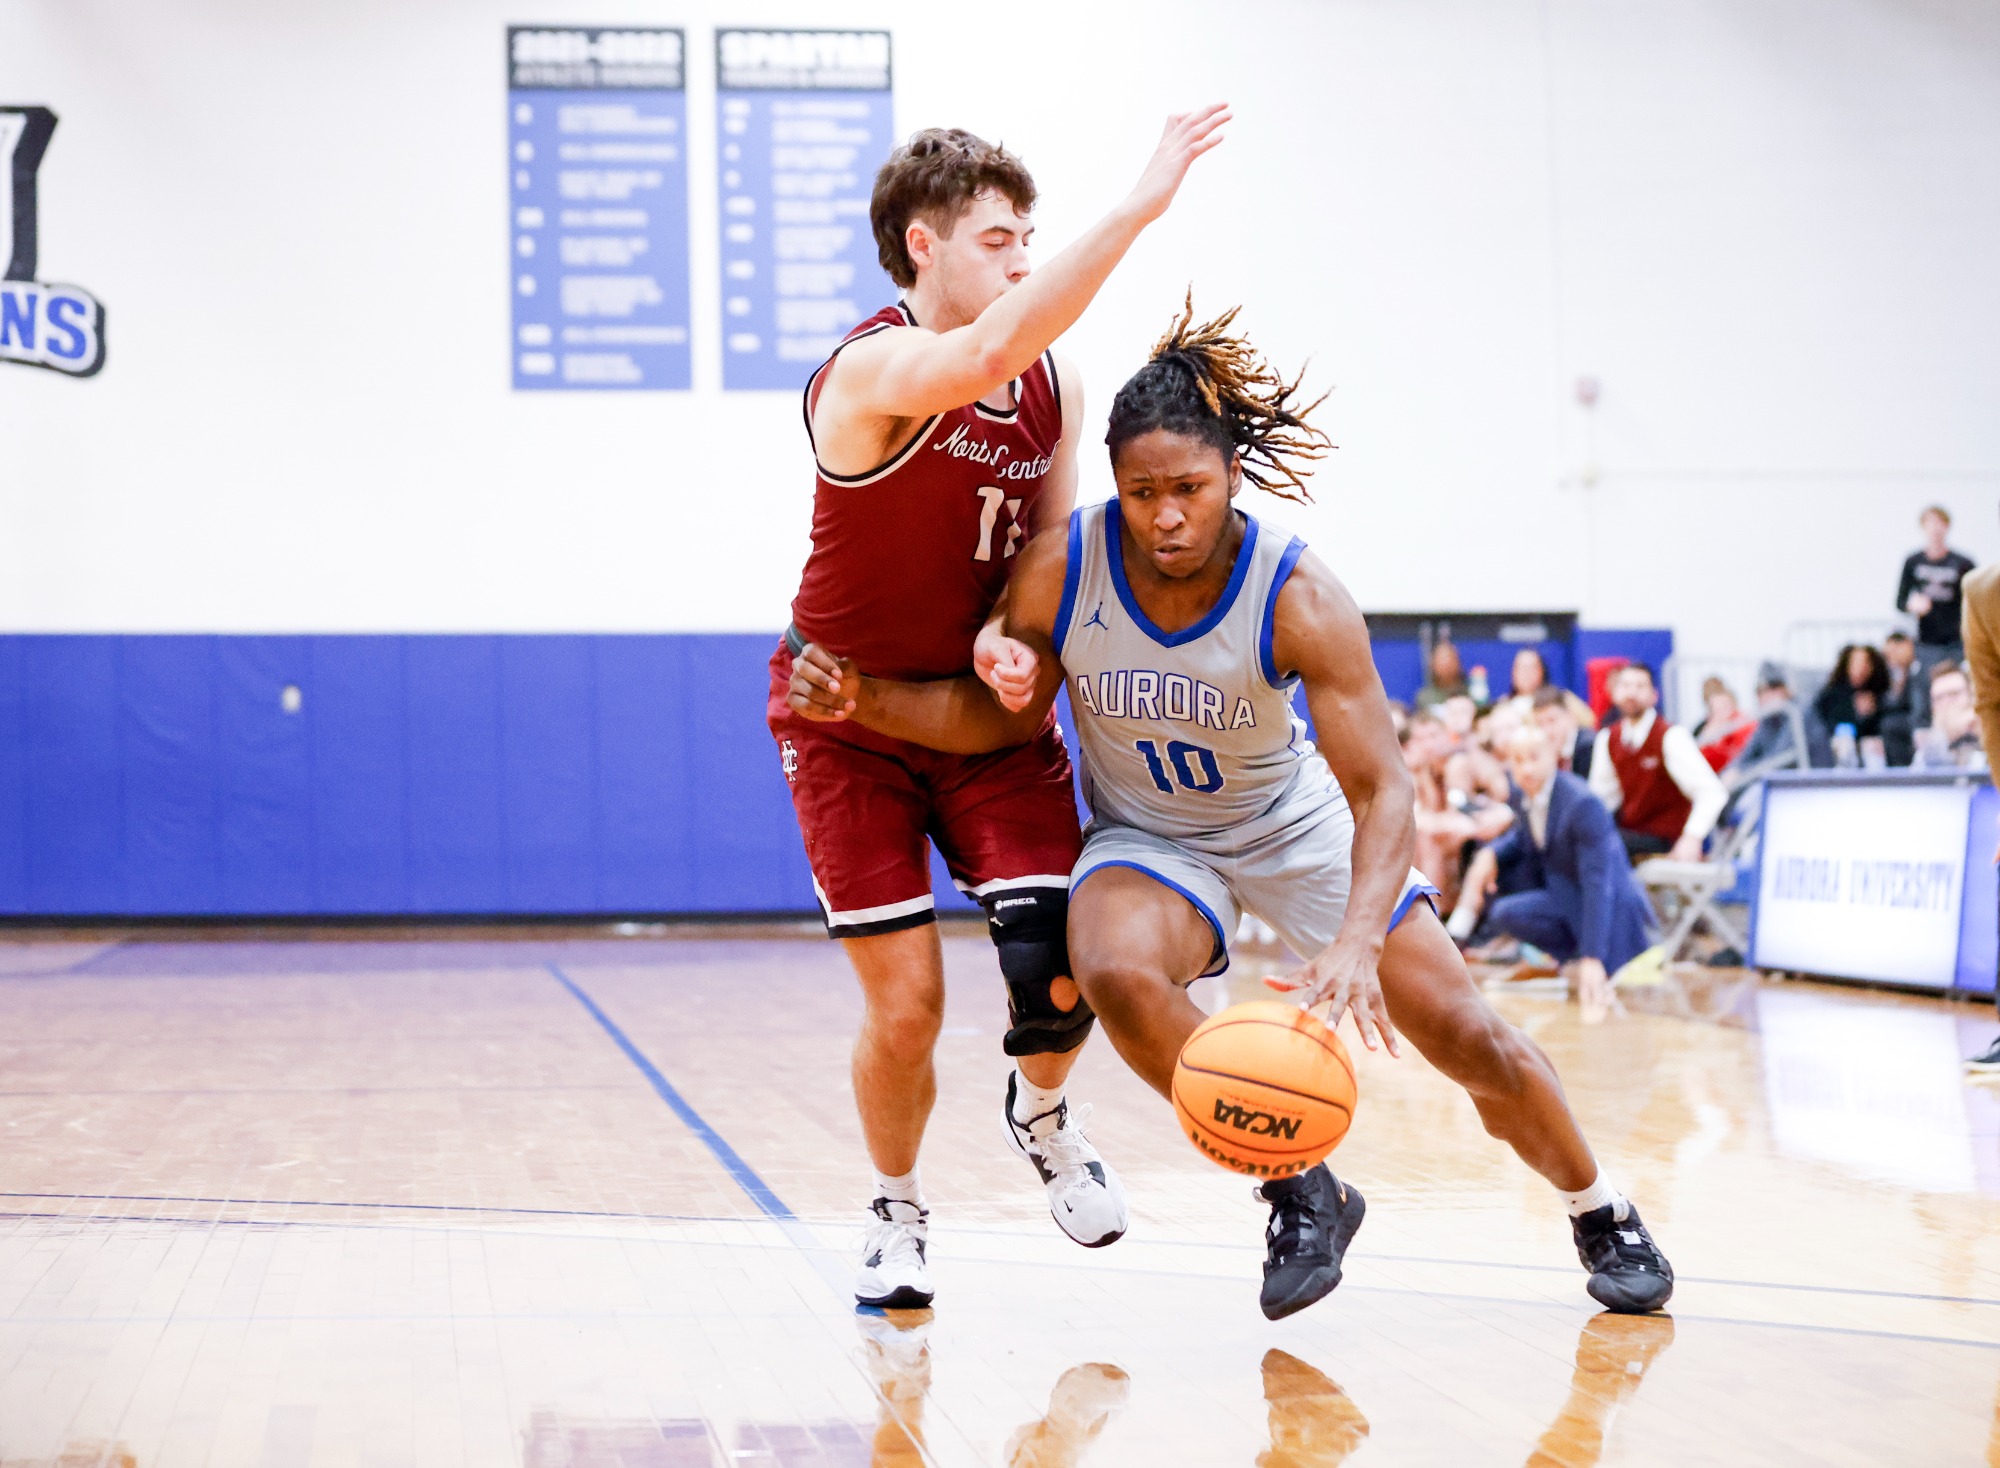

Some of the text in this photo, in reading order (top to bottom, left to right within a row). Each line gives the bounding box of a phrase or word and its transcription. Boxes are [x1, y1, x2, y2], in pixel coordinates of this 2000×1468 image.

[933, 423, 996, 466] Nort
[1077, 670, 1257, 731] AURORA
[1134, 739, 1227, 795] 10
[1214, 1098, 1303, 1140] NCAA
